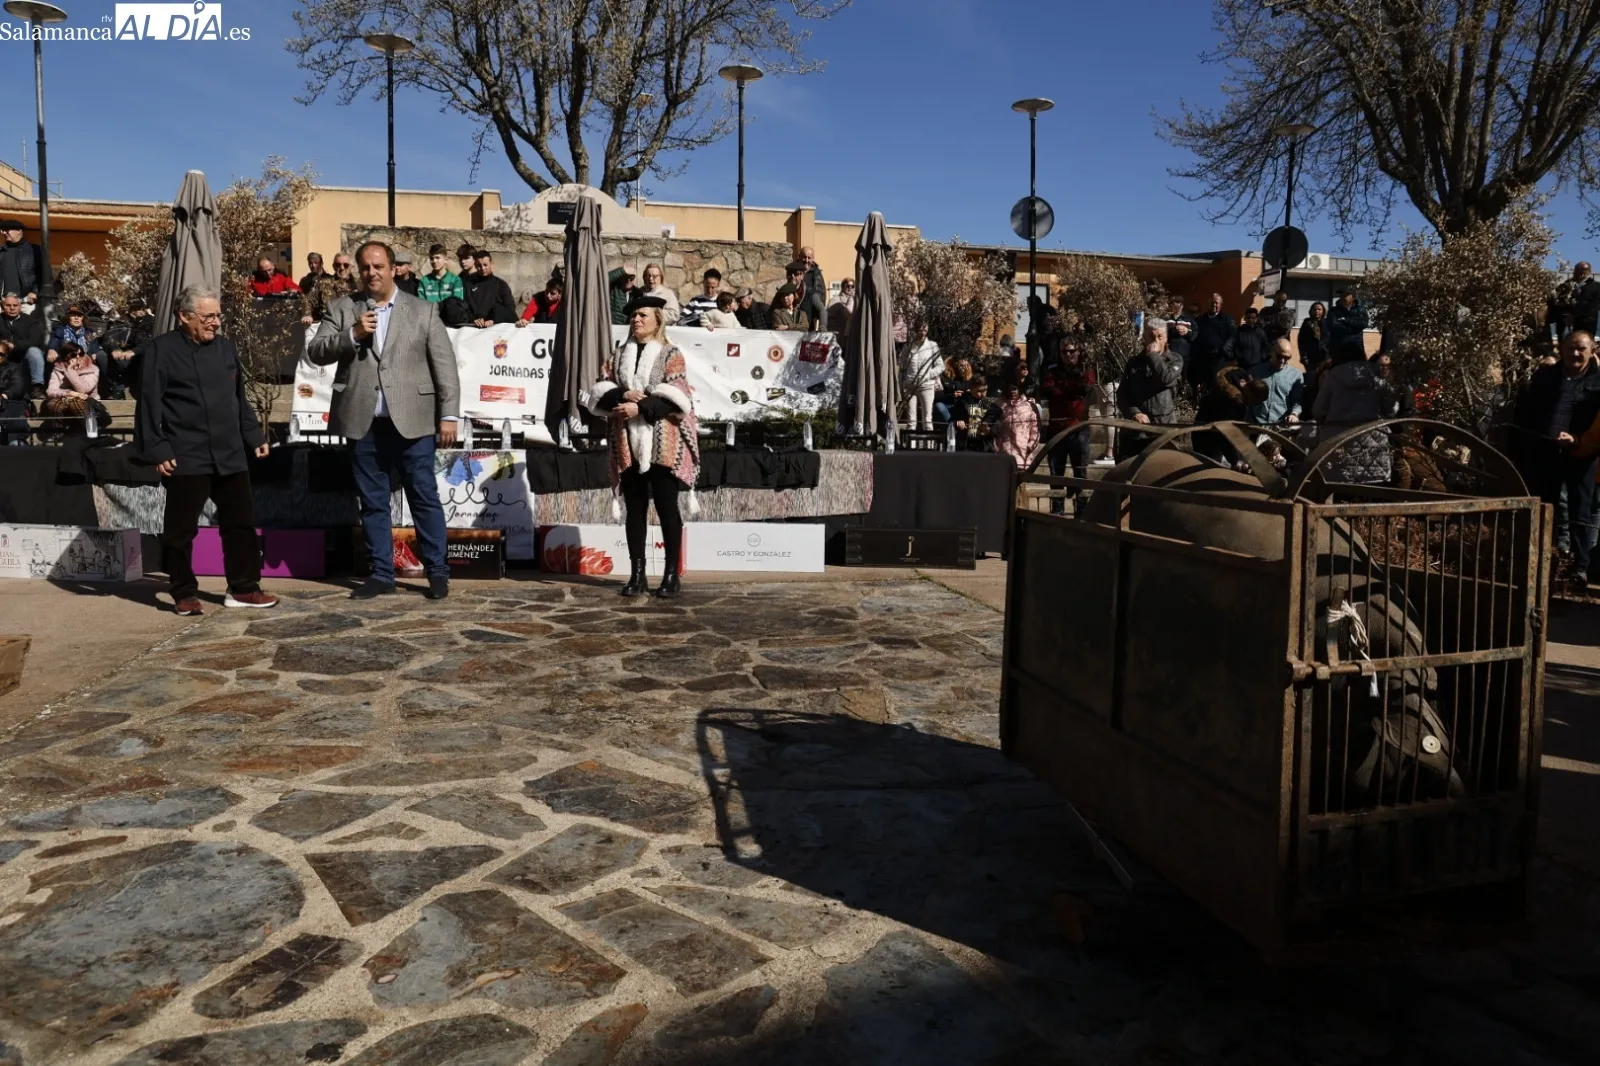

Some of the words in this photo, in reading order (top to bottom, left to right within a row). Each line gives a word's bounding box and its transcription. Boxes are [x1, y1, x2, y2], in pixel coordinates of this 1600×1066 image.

[489, 365, 545, 379] JORNADAS
[446, 506, 499, 522] Jornadas
[447, 543, 495, 552] HERNÁNDEZ
[447, 551, 480, 559] JIMÉNEZ
[753, 550, 791, 558] GONZÁLEZ
